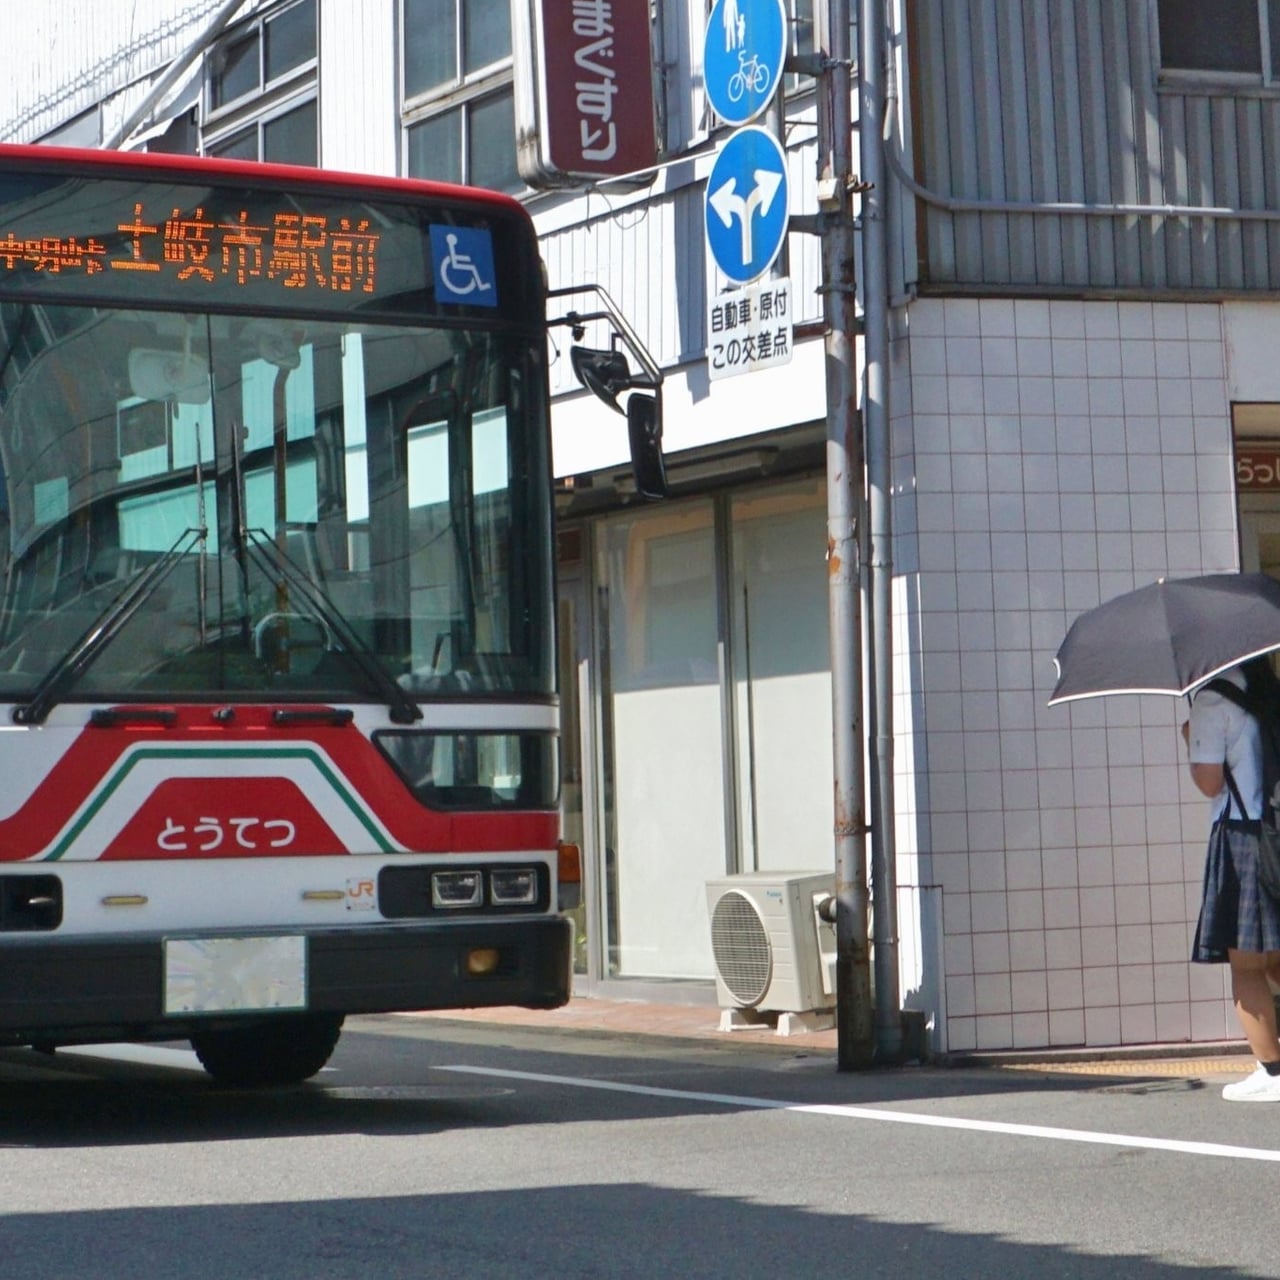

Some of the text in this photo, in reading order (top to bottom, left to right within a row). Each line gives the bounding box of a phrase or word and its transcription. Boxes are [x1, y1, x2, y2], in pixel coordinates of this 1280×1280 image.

[111, 202, 380, 293] 土岐市駅前
[711, 287, 788, 333] 自動車・原付
[712, 326, 789, 370] この交差点
[157, 816, 296, 851] とうてつ
[349, 881, 375, 898] JR
